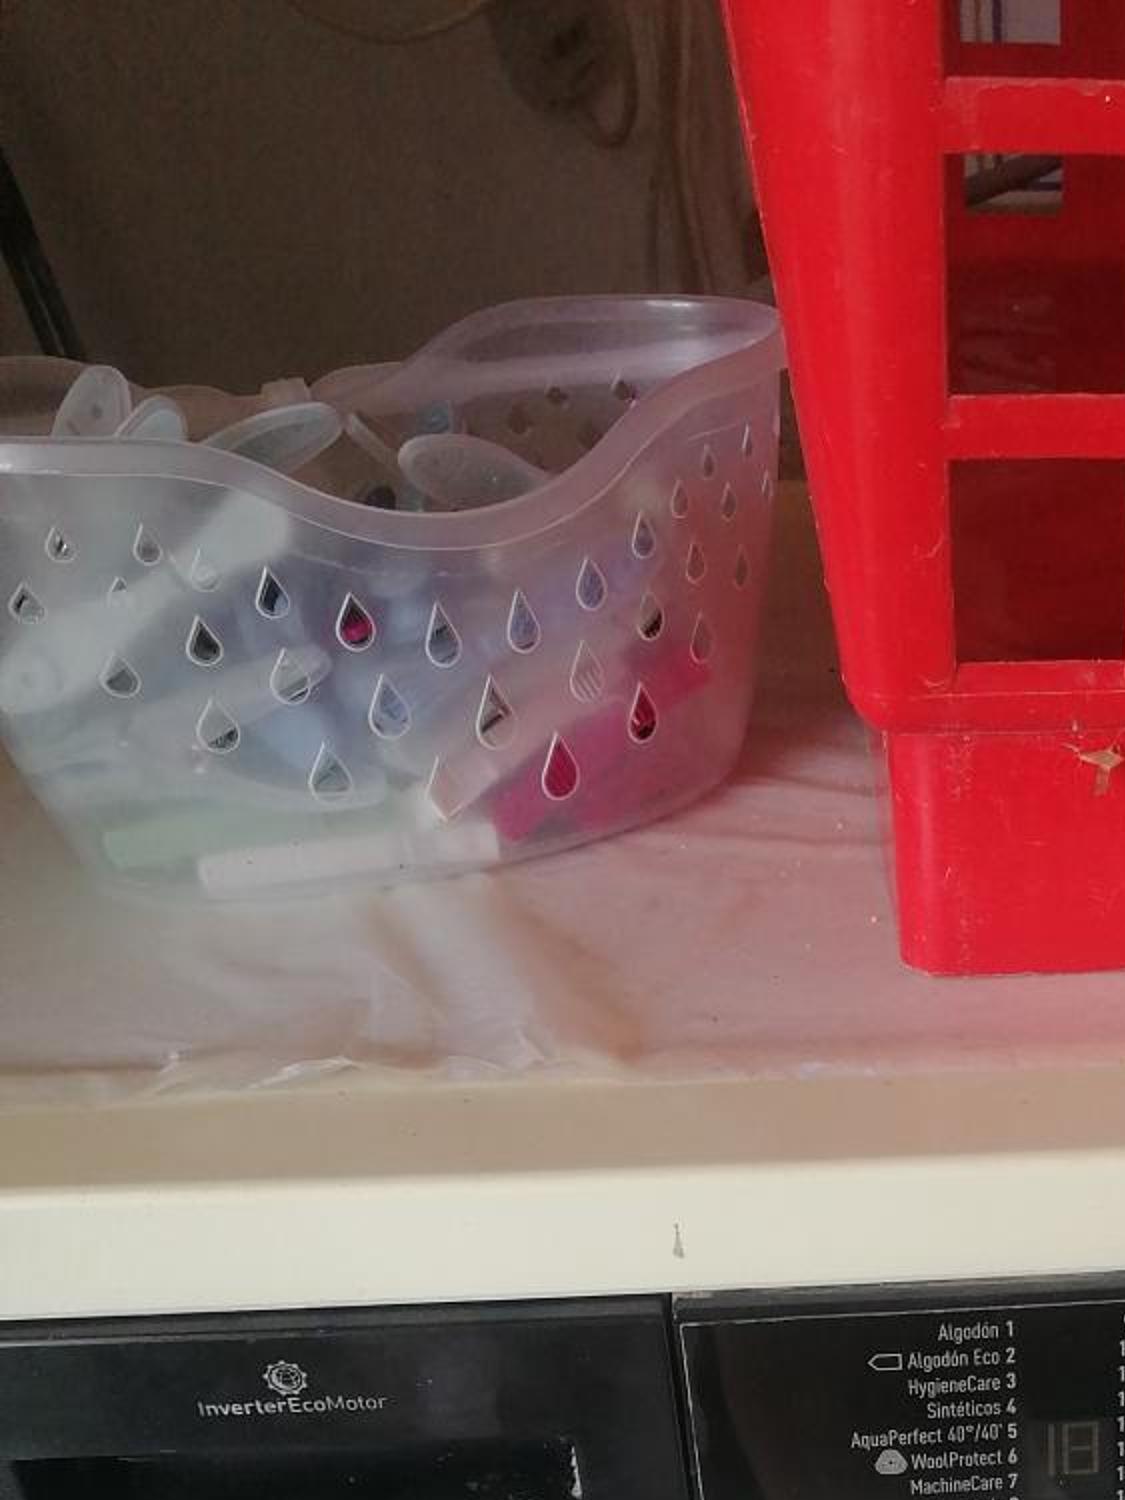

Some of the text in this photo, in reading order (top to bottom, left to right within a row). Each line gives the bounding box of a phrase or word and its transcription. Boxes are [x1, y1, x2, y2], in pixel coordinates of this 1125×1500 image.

[938, 1320, 1014, 1344] Algodón 1
[907, 1347, 1016, 1373] Algodón Eco 2
[908, 1373, 1017, 1399] HygieneCare 3
[198, 1395, 388, 1417] InverterEcoMotor
[927, 1397, 1017, 1420] Sintéticos 4
[851, 1428, 943, 1450] AquaPerfect
[1007, 1423, 1018, 1439] 5
[911, 1448, 1018, 1470] WoolProtect 6
[910, 1473, 1018, 1495] MachineCare 7
